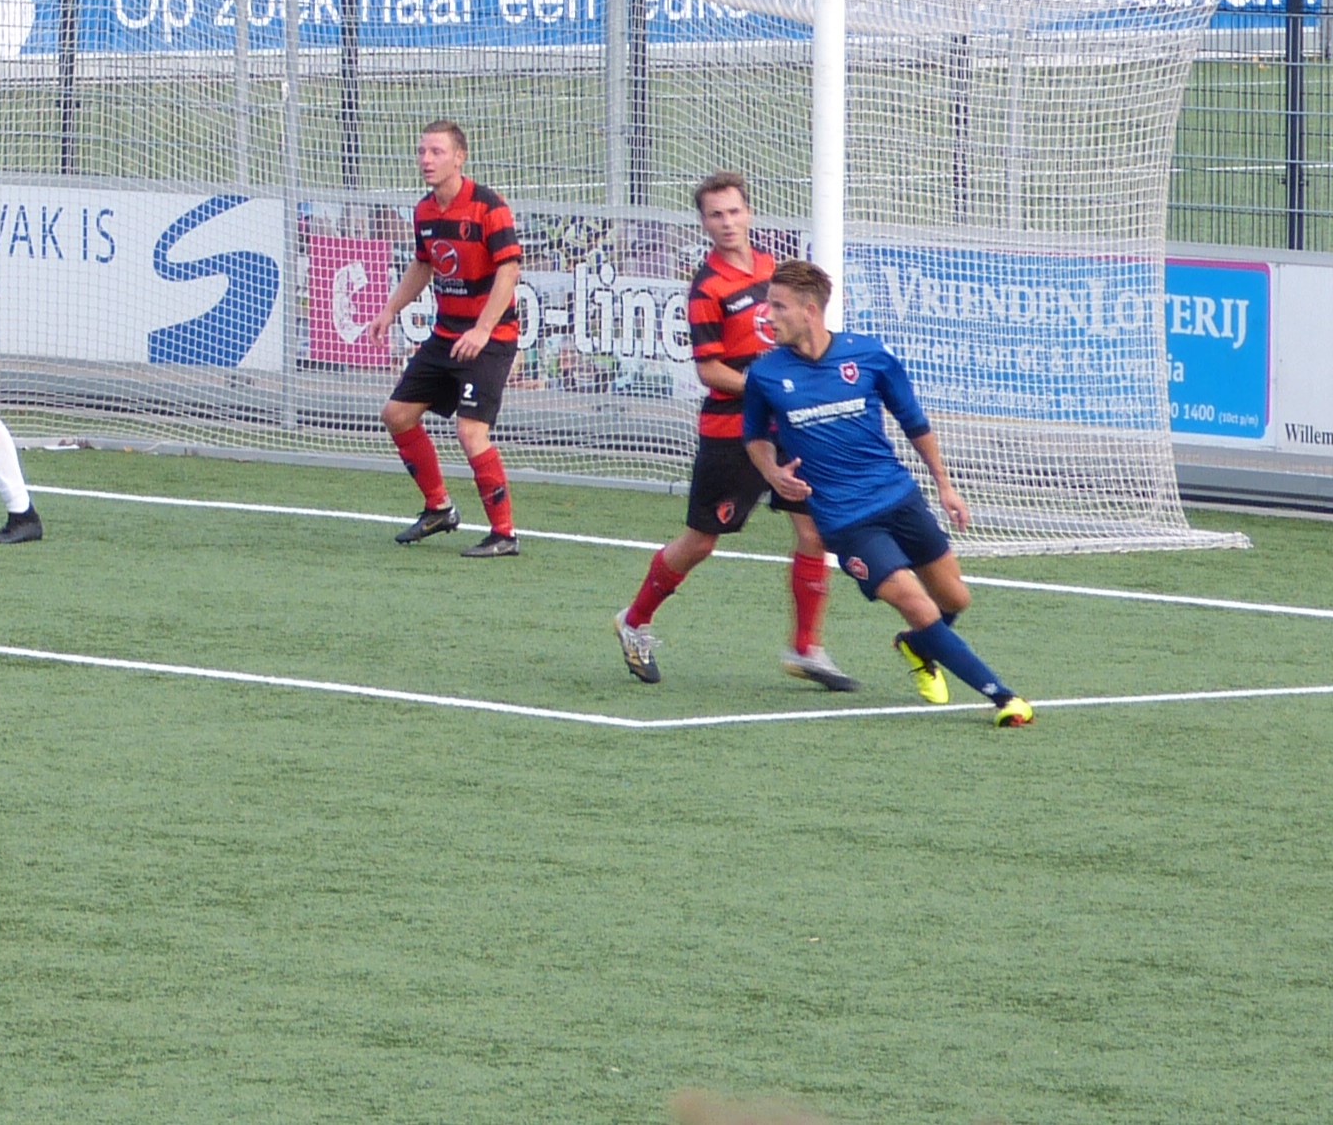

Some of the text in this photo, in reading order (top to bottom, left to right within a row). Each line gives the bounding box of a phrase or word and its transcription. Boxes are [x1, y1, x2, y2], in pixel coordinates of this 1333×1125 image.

[81, 208, 116, 264] IS
[463, 383, 474, 399] 2
[1184, 403, 1215, 422] 1400
